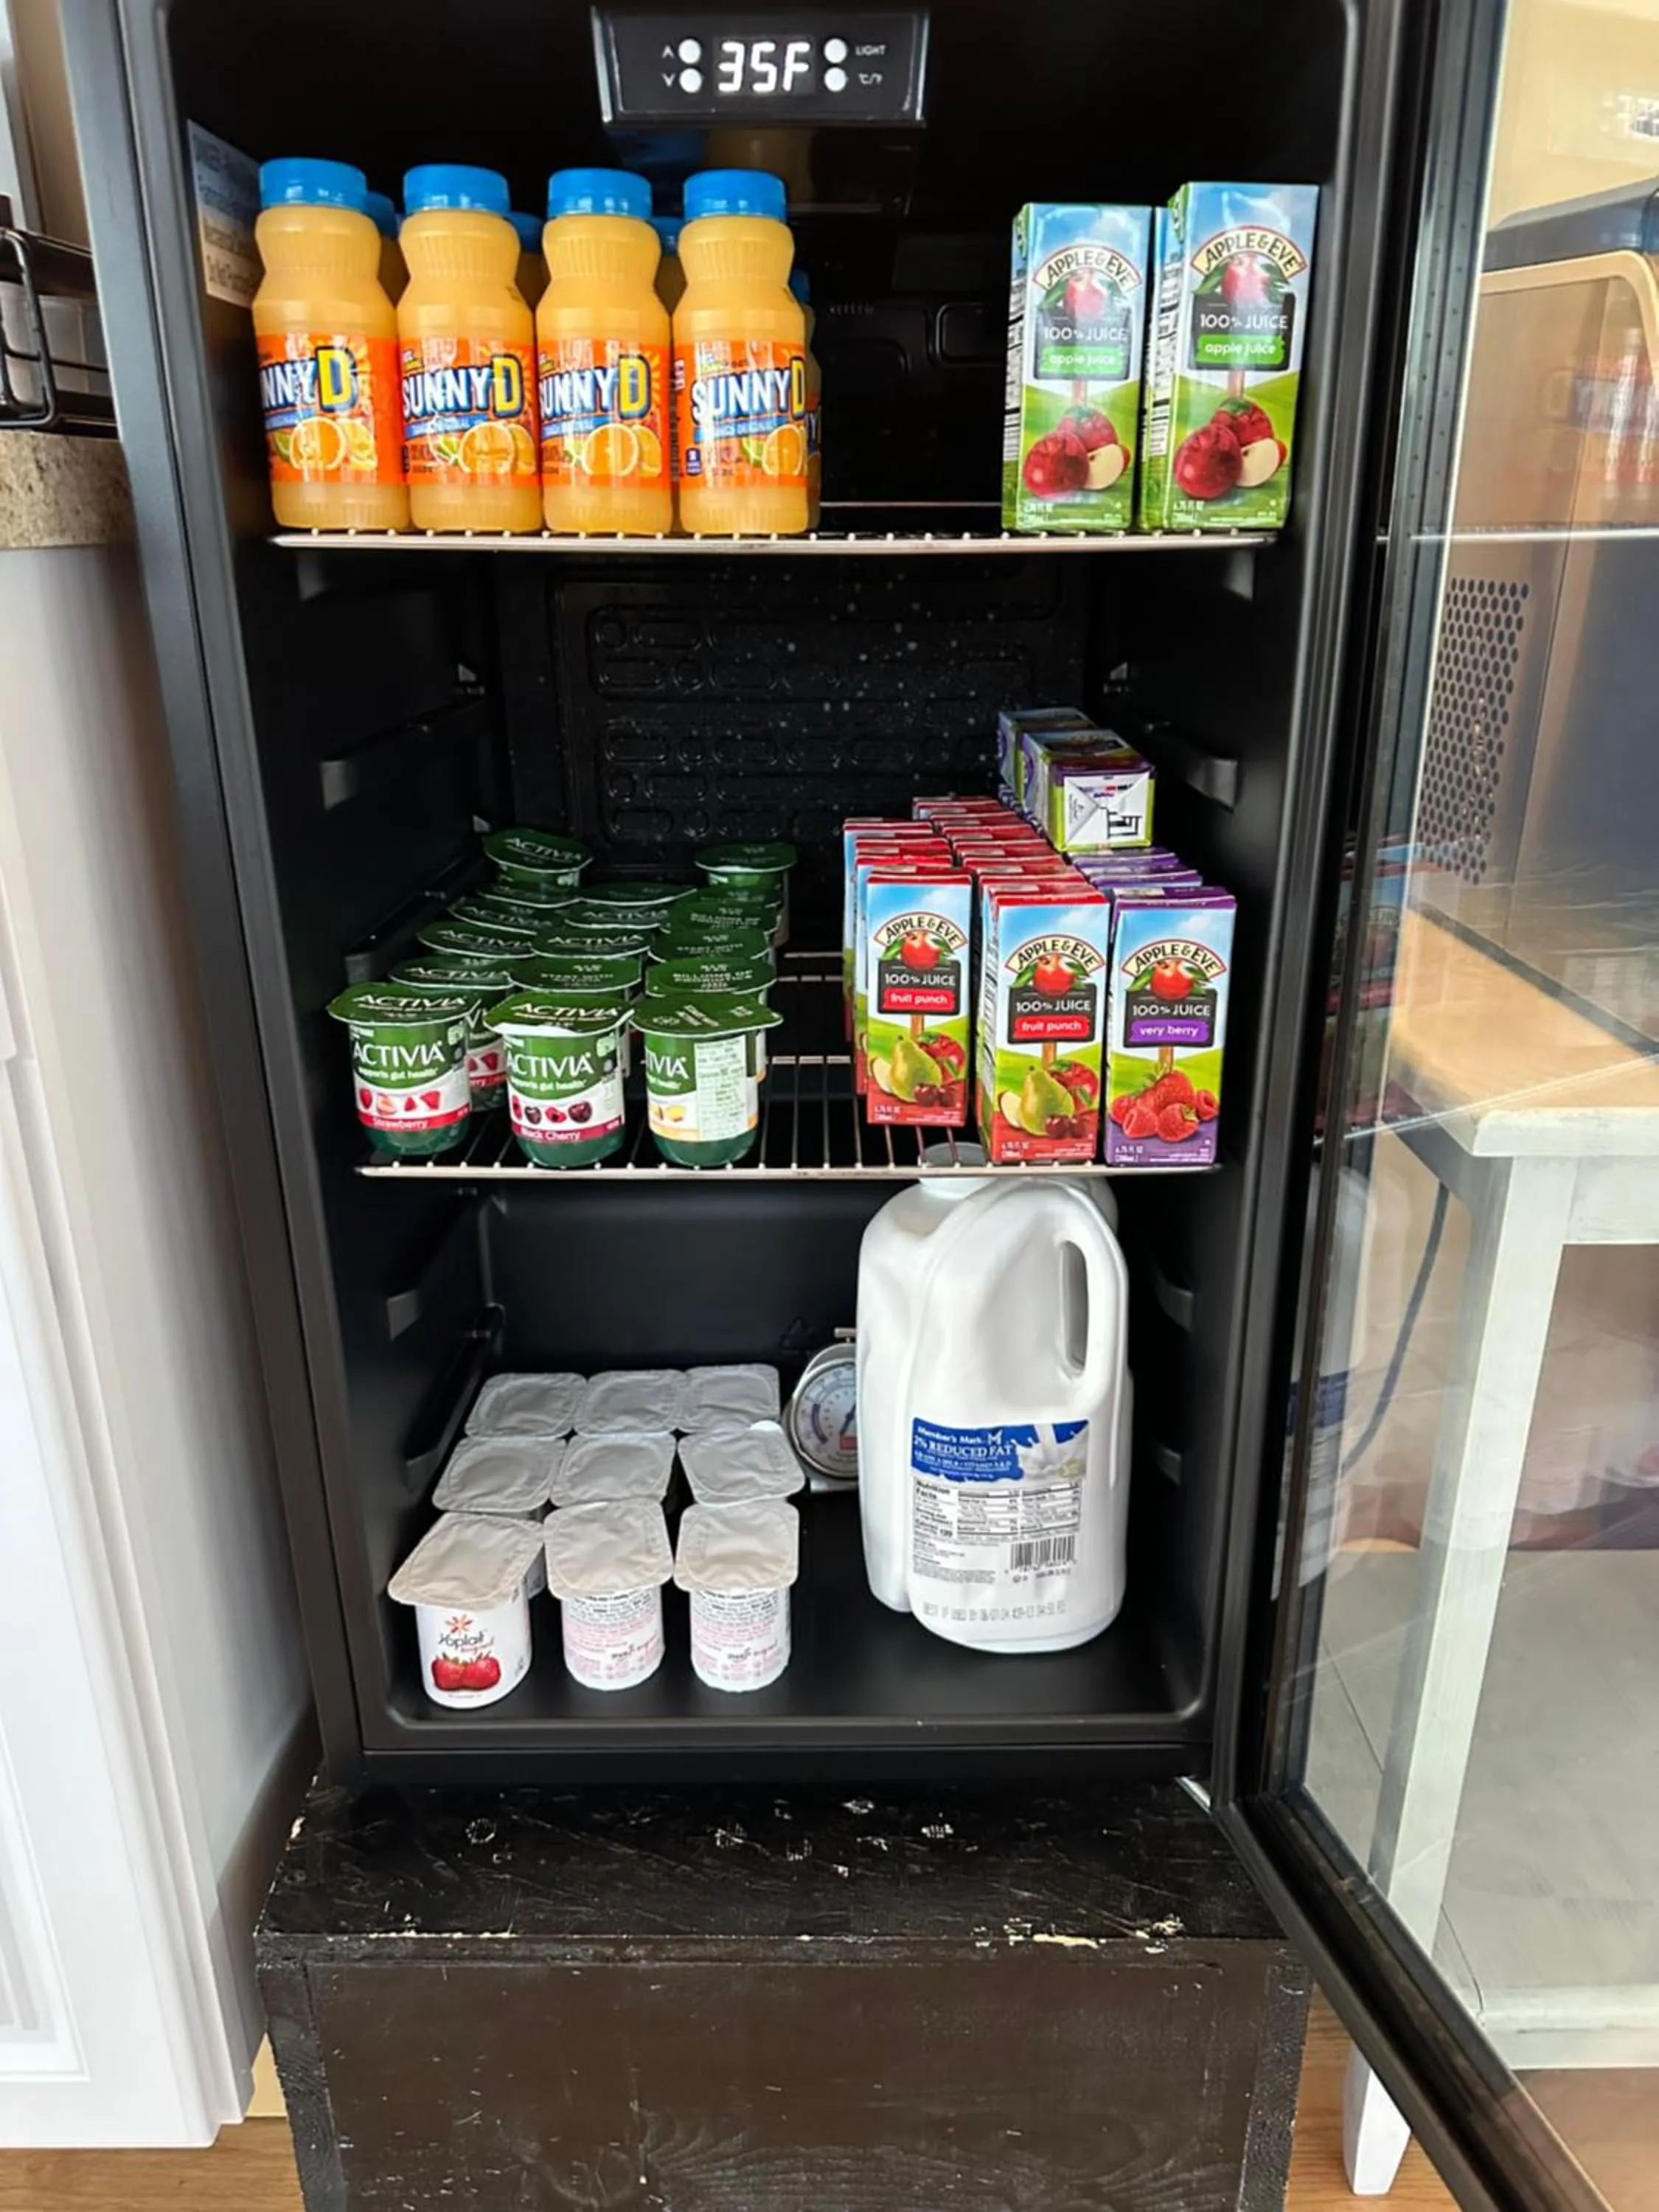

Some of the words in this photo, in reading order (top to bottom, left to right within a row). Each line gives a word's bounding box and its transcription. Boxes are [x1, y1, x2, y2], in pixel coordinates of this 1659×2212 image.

[855, 45, 886, 56] LIGHT
[717, 41, 811, 93] 35F
[1200, 313, 1243, 329] 100%
[1245, 313, 1289, 330] JUICE
[1043, 327, 1085, 340] 100%
[1086, 327, 1128, 341] JUICE
[1205, 342, 1243, 356] apple
[1244, 342, 1276, 357] juice
[1049, 354, 1085, 366] apple
[1086, 354, 1115, 366] juice
[260, 346, 358, 411] NNYD
[886, 973, 921, 985] 100%
[921, 974, 956, 987] JUICE
[353, 995, 467, 1007] ACTIVIA
[890, 992, 913, 1004] fruit
[914, 994, 947, 1005] punch
[511, 1002, 619, 1018] ACTIVIA
[1015, 1001, 1053, 1012] 100%
[1054, 1000, 1091, 1012] JUICE
[1132, 1004, 1170, 1016] 100%
[1172, 1004, 1211, 1016] JUICE
[1021, 1021, 1045, 1032] fruit
[1046, 1020, 1082, 1033] punch
[1138, 1025, 1165, 1037] very
[1166, 1024, 1199, 1038] berry
[352, 1040, 446, 1068] ACTIVIA
[507, 1048, 595, 1079] ACTIVIA
[372, 1116, 428, 1130] Strawberry
[546, 1130, 581, 1142] Cherry
[929, 1441, 988, 1457] REDUCED
[989, 1444, 1013, 1456] FAT
[438, 1630, 484, 1650] Yoplait
